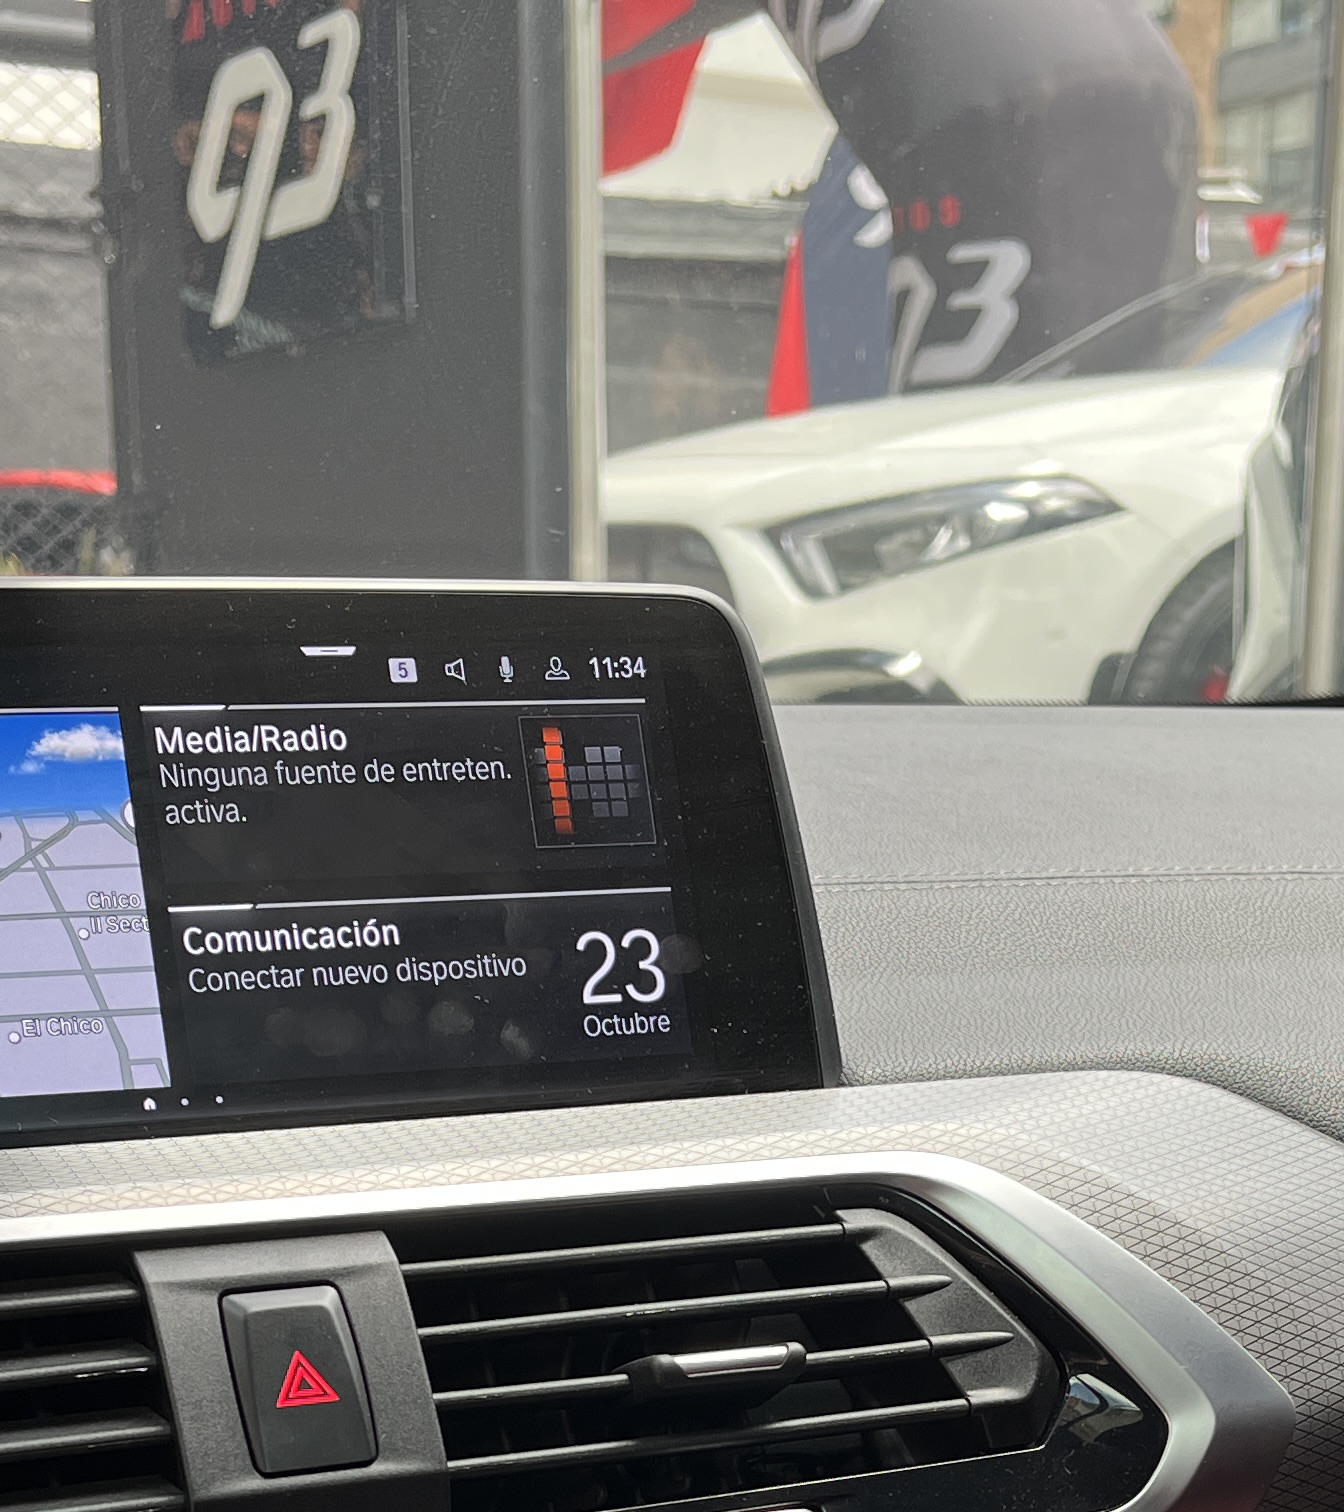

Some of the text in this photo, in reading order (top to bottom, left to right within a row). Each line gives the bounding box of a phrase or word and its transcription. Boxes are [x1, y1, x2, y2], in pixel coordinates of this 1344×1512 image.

[186, 8, 360, 328] 93
[589, 656, 646, 679] 11:34
[155, 724, 347, 754] Media/Radio
[159, 757, 512, 792] Ninguna fuente de entreten.
[165, 800, 248, 825] activa.
[87, 891, 141, 910] Chico
[183, 919, 400, 955] Comunicación
[188, 953, 527, 993] Conectar nuevo dispositivo
[576, 928, 666, 1005] 23
[22, 1016, 104, 1038] El Chico
[583, 1012, 671, 1037] Octubre
